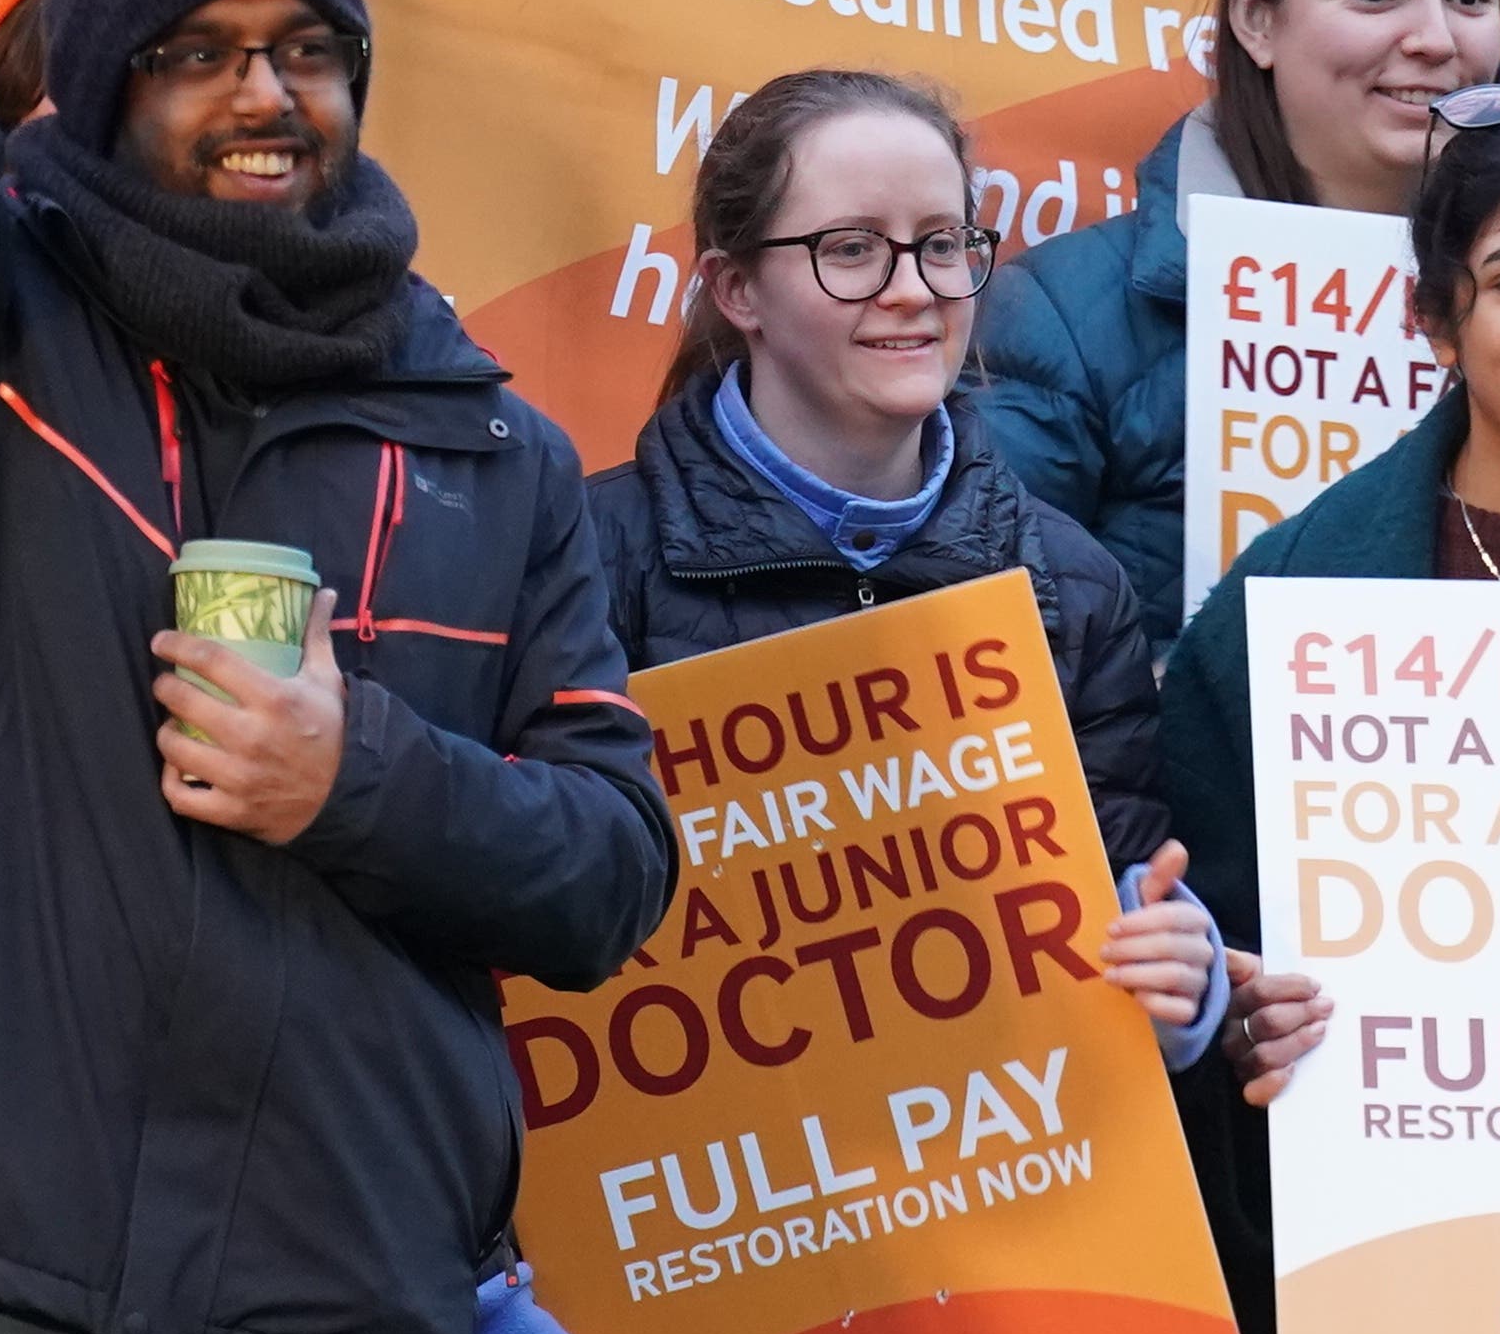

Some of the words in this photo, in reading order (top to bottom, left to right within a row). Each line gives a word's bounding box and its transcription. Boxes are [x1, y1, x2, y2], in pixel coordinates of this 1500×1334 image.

[1221, 340, 1338, 400] NOT
[1353, 356, 1390, 408] A
[1221, 410, 1360, 484] FOR
[940, 638, 1021, 722] IS
[681, 778, 835, 866] FAIR
[841, 722, 1046, 825] WAGE
[1290, 714, 1428, 763] NOT
[1448, 718, 1494, 767] A
[1293, 780, 1460, 844] FOR
[681, 887, 758, 959] A
[760, 794, 1070, 951] JUNIOR
[504, 879, 1099, 1132] DOCTOR
[598, 1114, 876, 1250] FULL
[890, 1047, 1070, 1173] PAY
[625, 1179, 972, 1303] RESTORATION
[977, 1139, 1095, 1211] NOW
